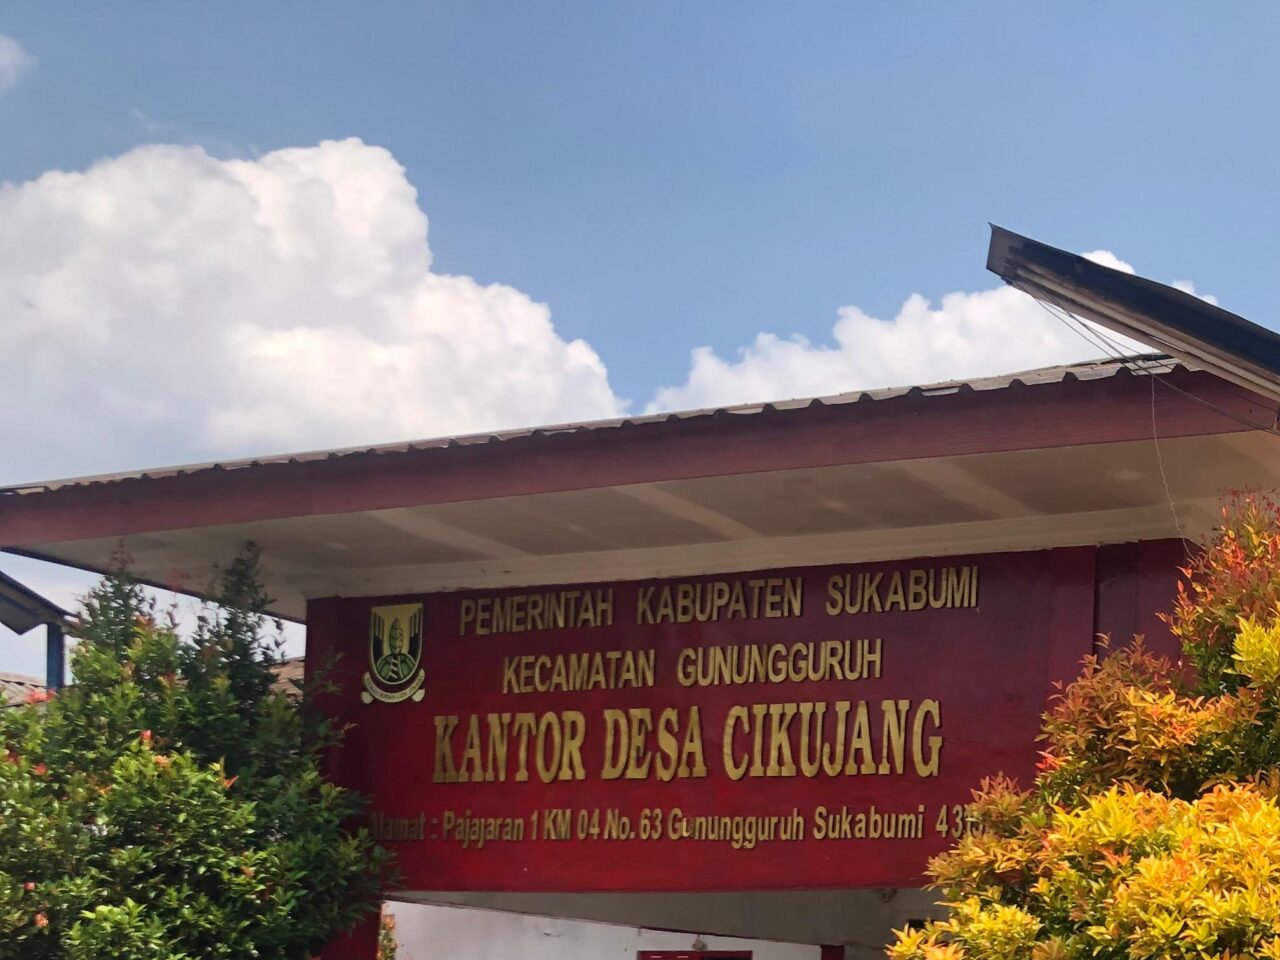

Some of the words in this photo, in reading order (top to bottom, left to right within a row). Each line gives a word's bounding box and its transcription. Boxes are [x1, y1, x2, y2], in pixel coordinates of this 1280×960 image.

[460, 588, 614, 636] PEMERINTAH
[637, 577, 802, 625] KABUPATEN
[825, 566, 978, 617] SUKABUMI
[503, 649, 656, 694] KECAMATAN
[677, 638, 882, 687] GUNUNGGURUH
[433, 710, 586, 783] KANTOR
[601, 705, 708, 782] DESA
[723, 699, 942, 780] CIKUJANG
[443, 809, 525, 849] Pajajaran
[543, 808, 572, 840] KM
[577, 808, 601, 840] 04
[639, 807, 663, 840] 63
[668, 806, 804, 850] Gunungguruh
[813, 805, 925, 841] Sukabumi
